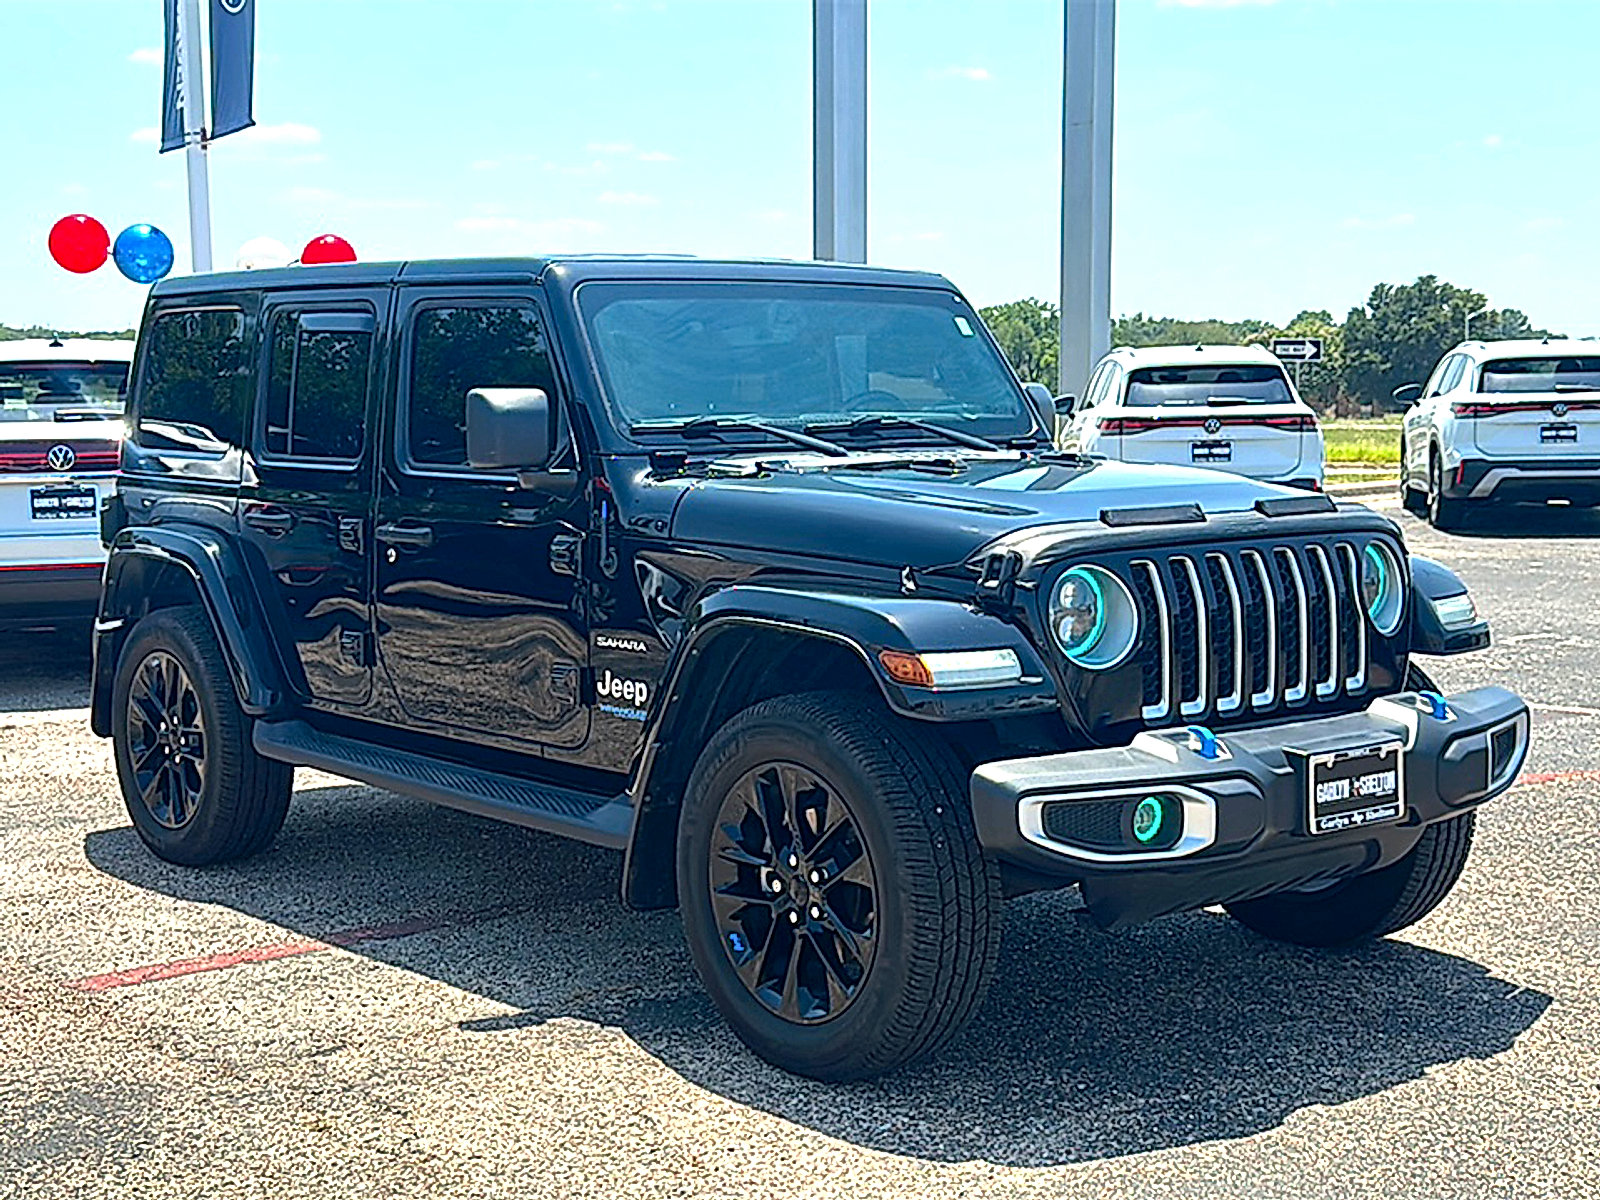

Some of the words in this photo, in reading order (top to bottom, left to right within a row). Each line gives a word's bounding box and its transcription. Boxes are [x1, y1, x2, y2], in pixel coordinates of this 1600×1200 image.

[597, 637, 647, 651] SAHARA
[597, 670, 647, 706] Jeep
[1360, 770, 1396, 795] SHELTON
